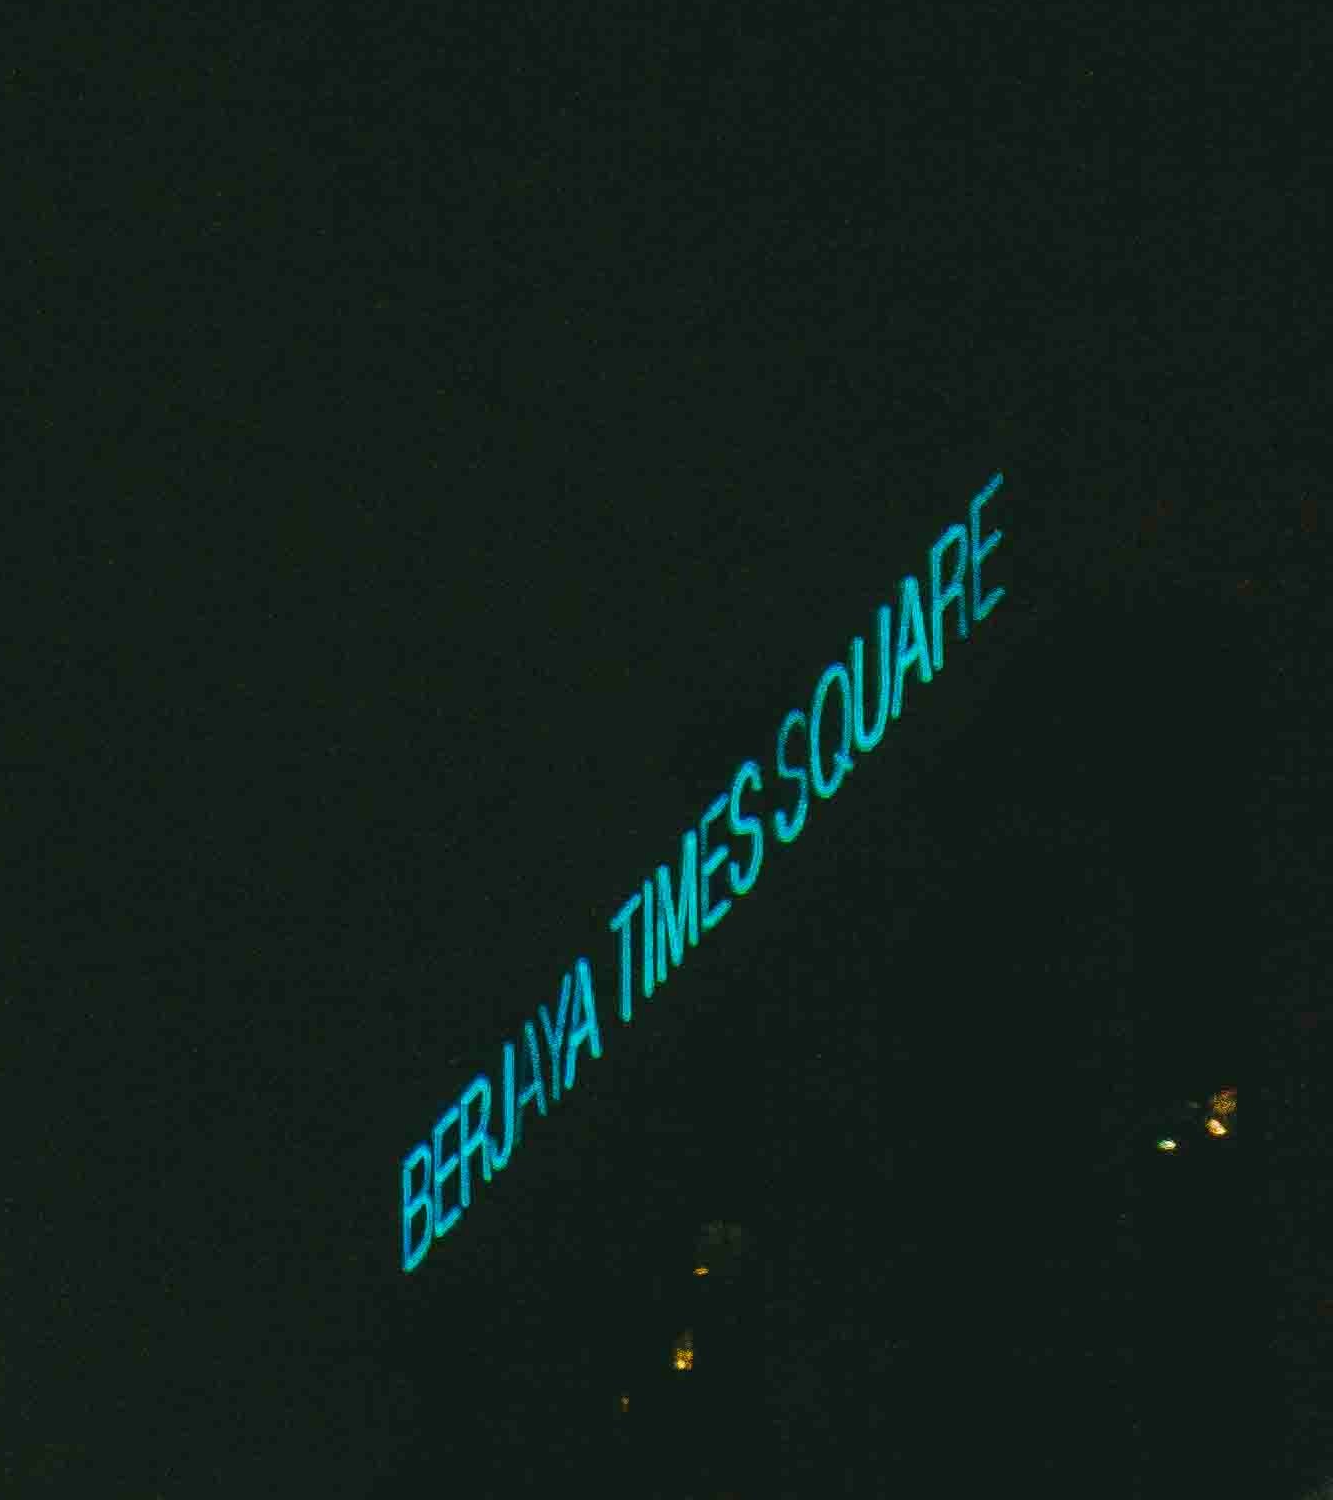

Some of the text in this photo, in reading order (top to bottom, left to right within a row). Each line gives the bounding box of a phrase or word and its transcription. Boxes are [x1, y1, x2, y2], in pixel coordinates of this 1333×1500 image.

[400, 472, 1007, 1273] BERJAYA TIMES SQUARE
